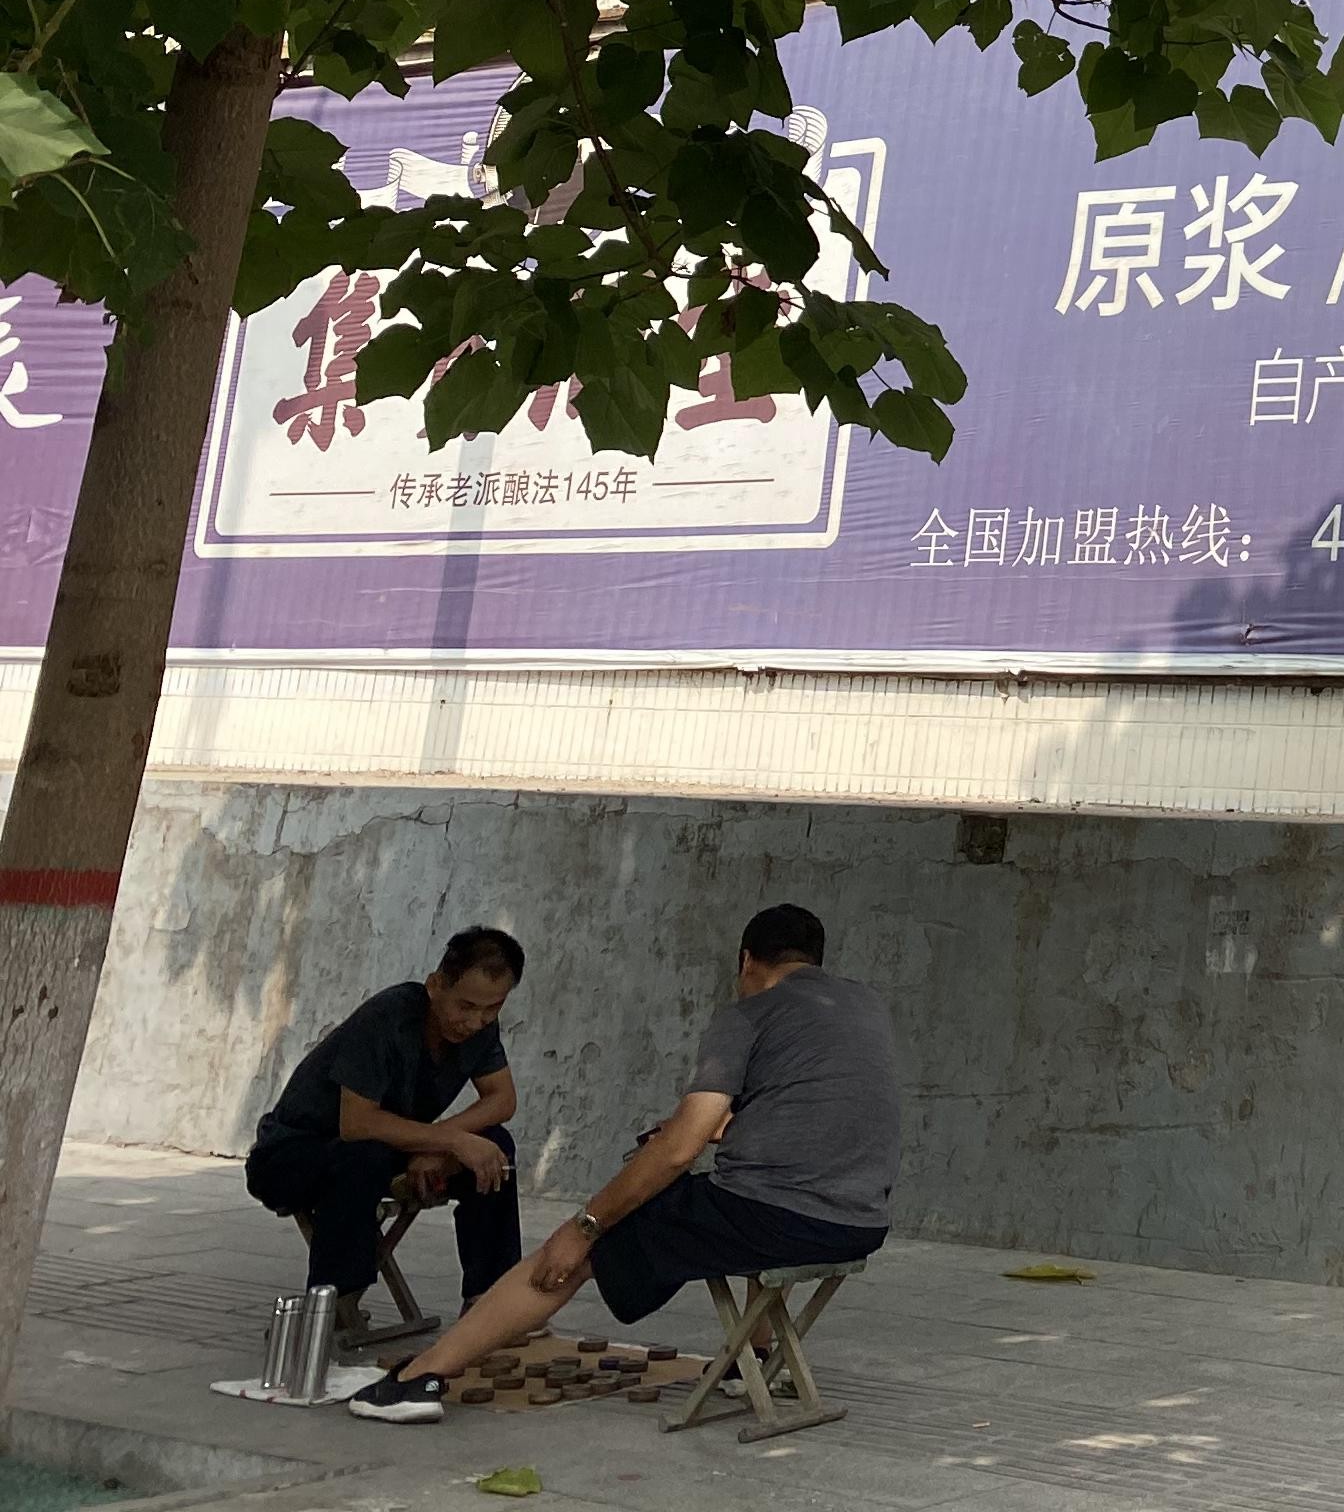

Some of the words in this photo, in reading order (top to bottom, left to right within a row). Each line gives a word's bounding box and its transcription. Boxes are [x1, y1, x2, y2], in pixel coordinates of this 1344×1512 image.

[389, 466, 639, 510] 传承老派酿法145年
